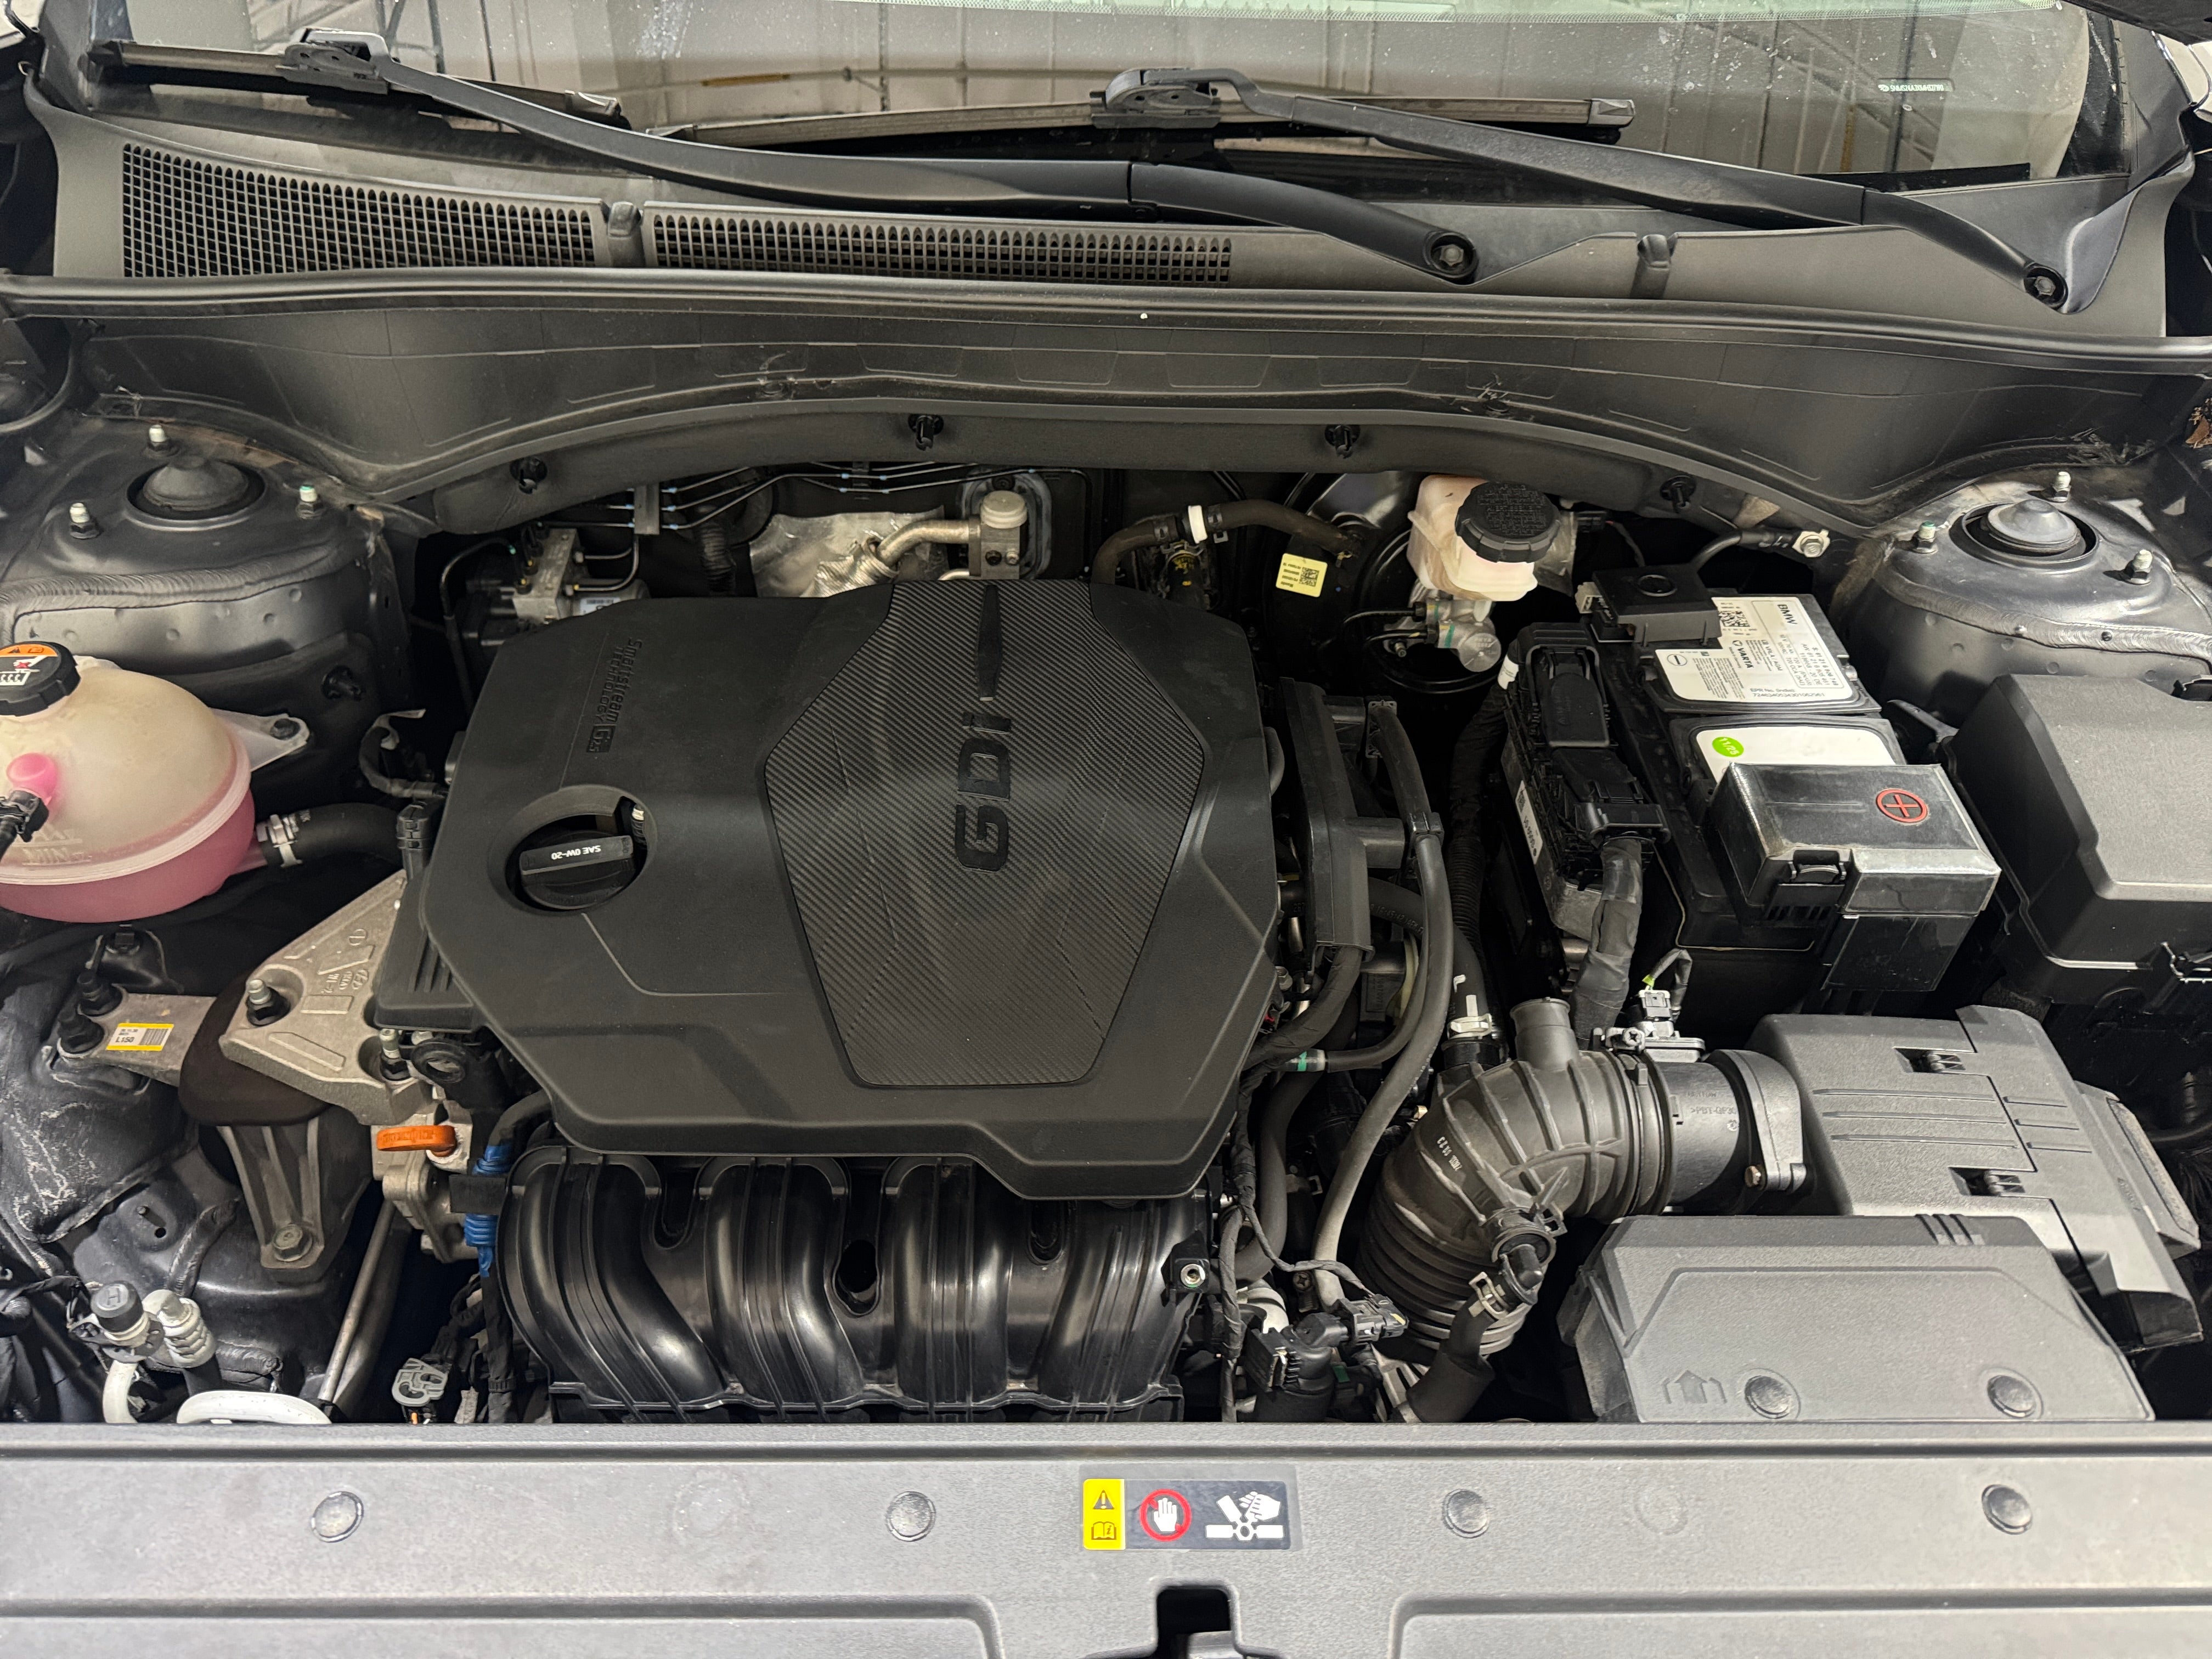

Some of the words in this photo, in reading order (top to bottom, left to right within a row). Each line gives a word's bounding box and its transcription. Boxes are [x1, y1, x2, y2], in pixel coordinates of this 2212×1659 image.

[1777, 604, 1797, 624] BMW
[1736, 647, 1754, 668] VARTA
[610, 638, 643, 724] Smartstream
[551, 848, 581, 860] 0W-20
[582, 844, 601, 854] SAE
